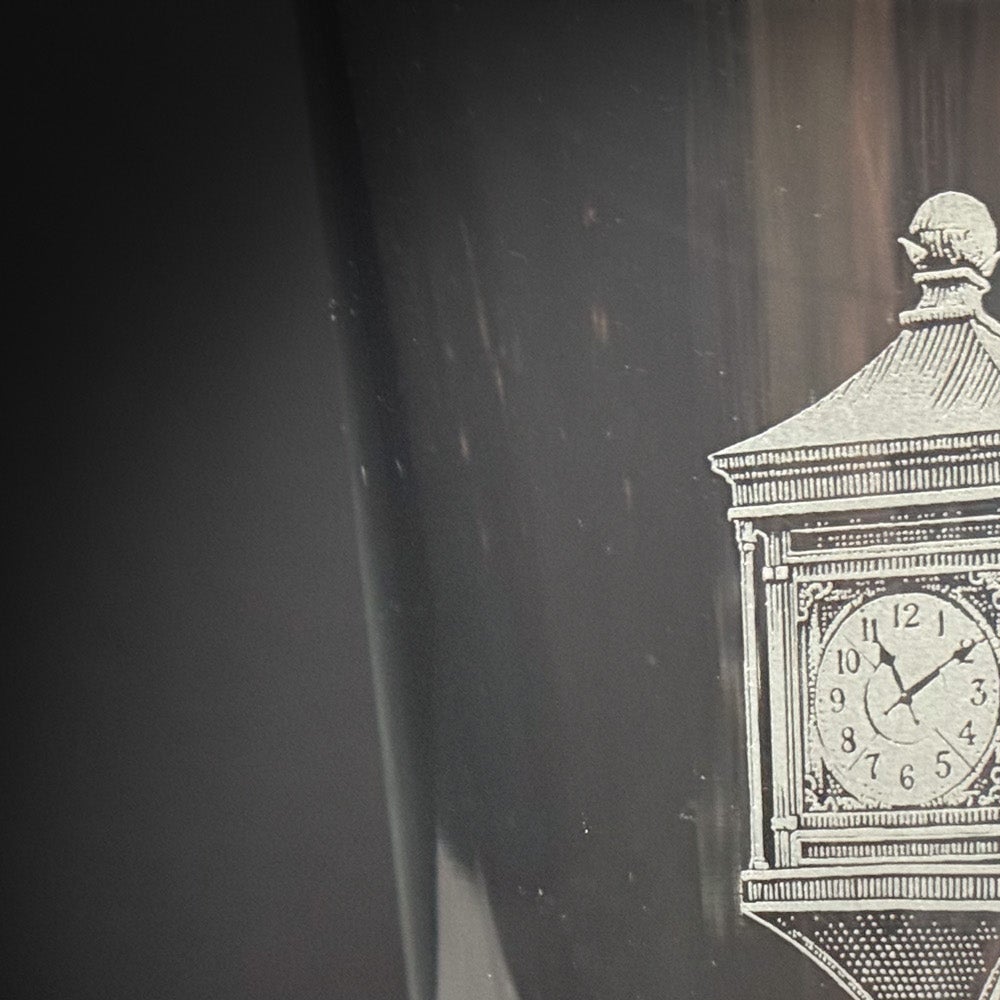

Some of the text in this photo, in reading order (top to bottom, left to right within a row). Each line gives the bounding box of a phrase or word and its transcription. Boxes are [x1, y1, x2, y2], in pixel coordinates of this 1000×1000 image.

[894, 603, 919, 628] 12
[938, 610, 945, 637] 1
[862, 617, 877, 641] 11
[837, 648, 860, 674] 10
[830, 687, 845, 713] 9
[970, 679, 987, 706] 3
[841, 727, 856, 753] 8
[958, 720, 976, 745] 4
[865, 753, 880, 780] 7
[900, 764, 914, 790] 6
[935, 751, 951, 778] 5
